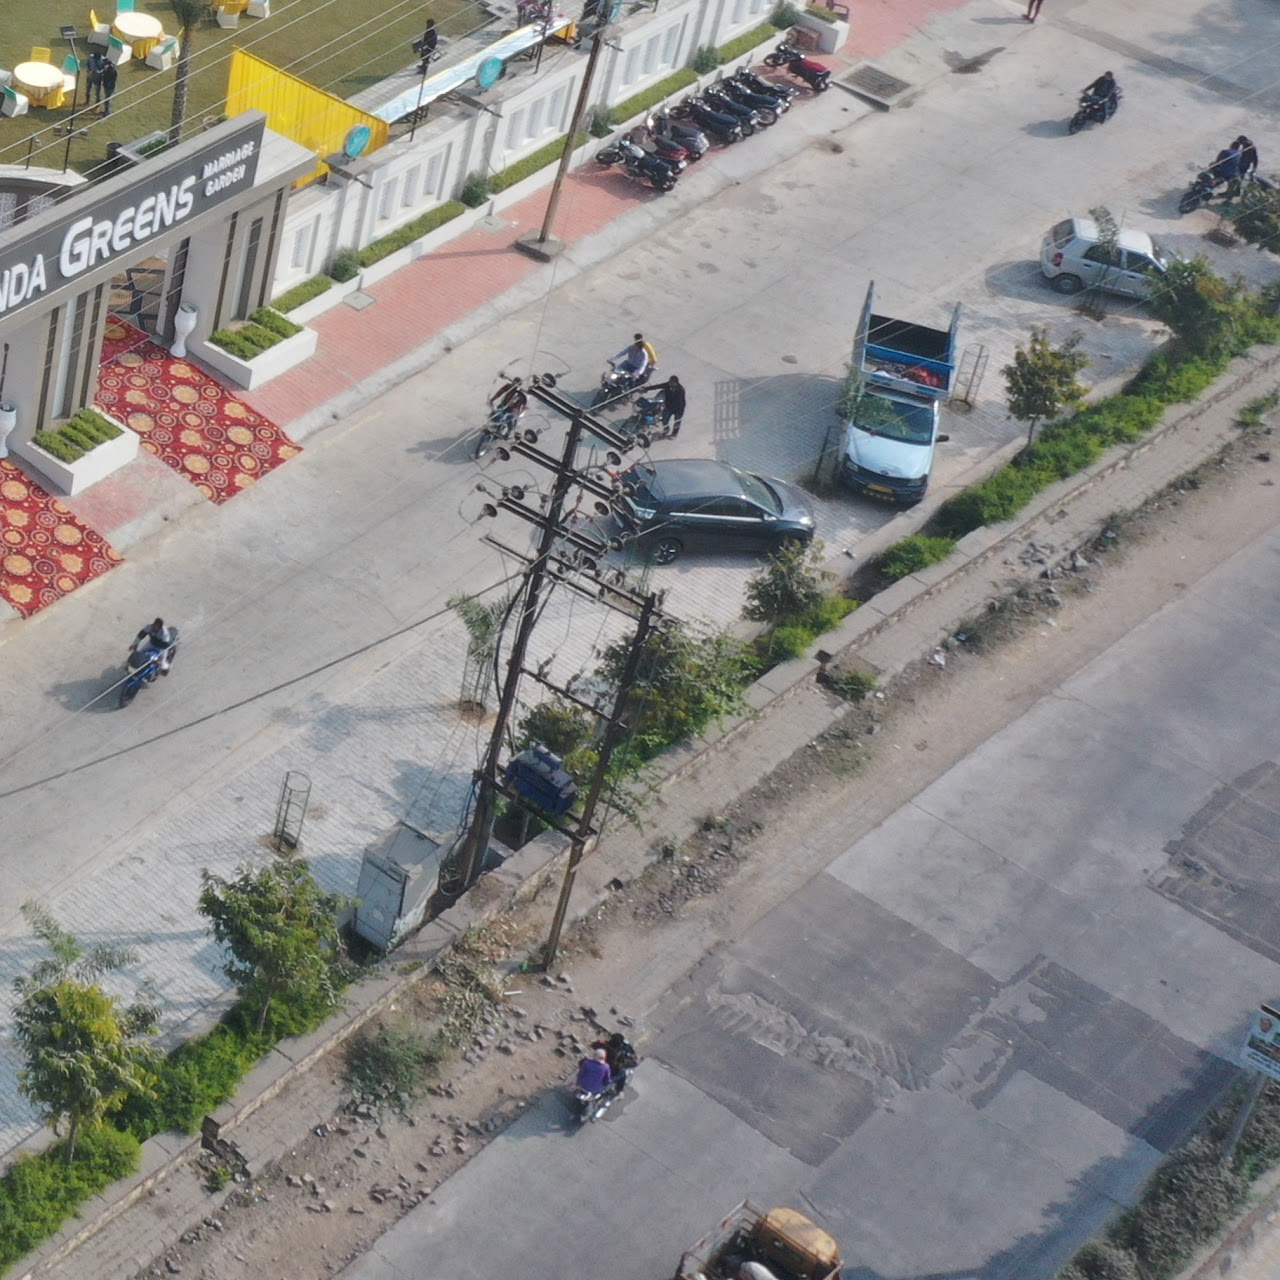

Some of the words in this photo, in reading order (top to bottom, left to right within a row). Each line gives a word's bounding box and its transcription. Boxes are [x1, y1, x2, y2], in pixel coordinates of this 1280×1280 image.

[203, 140, 255, 179] MARRIAGE
[205, 164, 246, 196] GARDEN
[60, 175, 196, 277] GREENS
